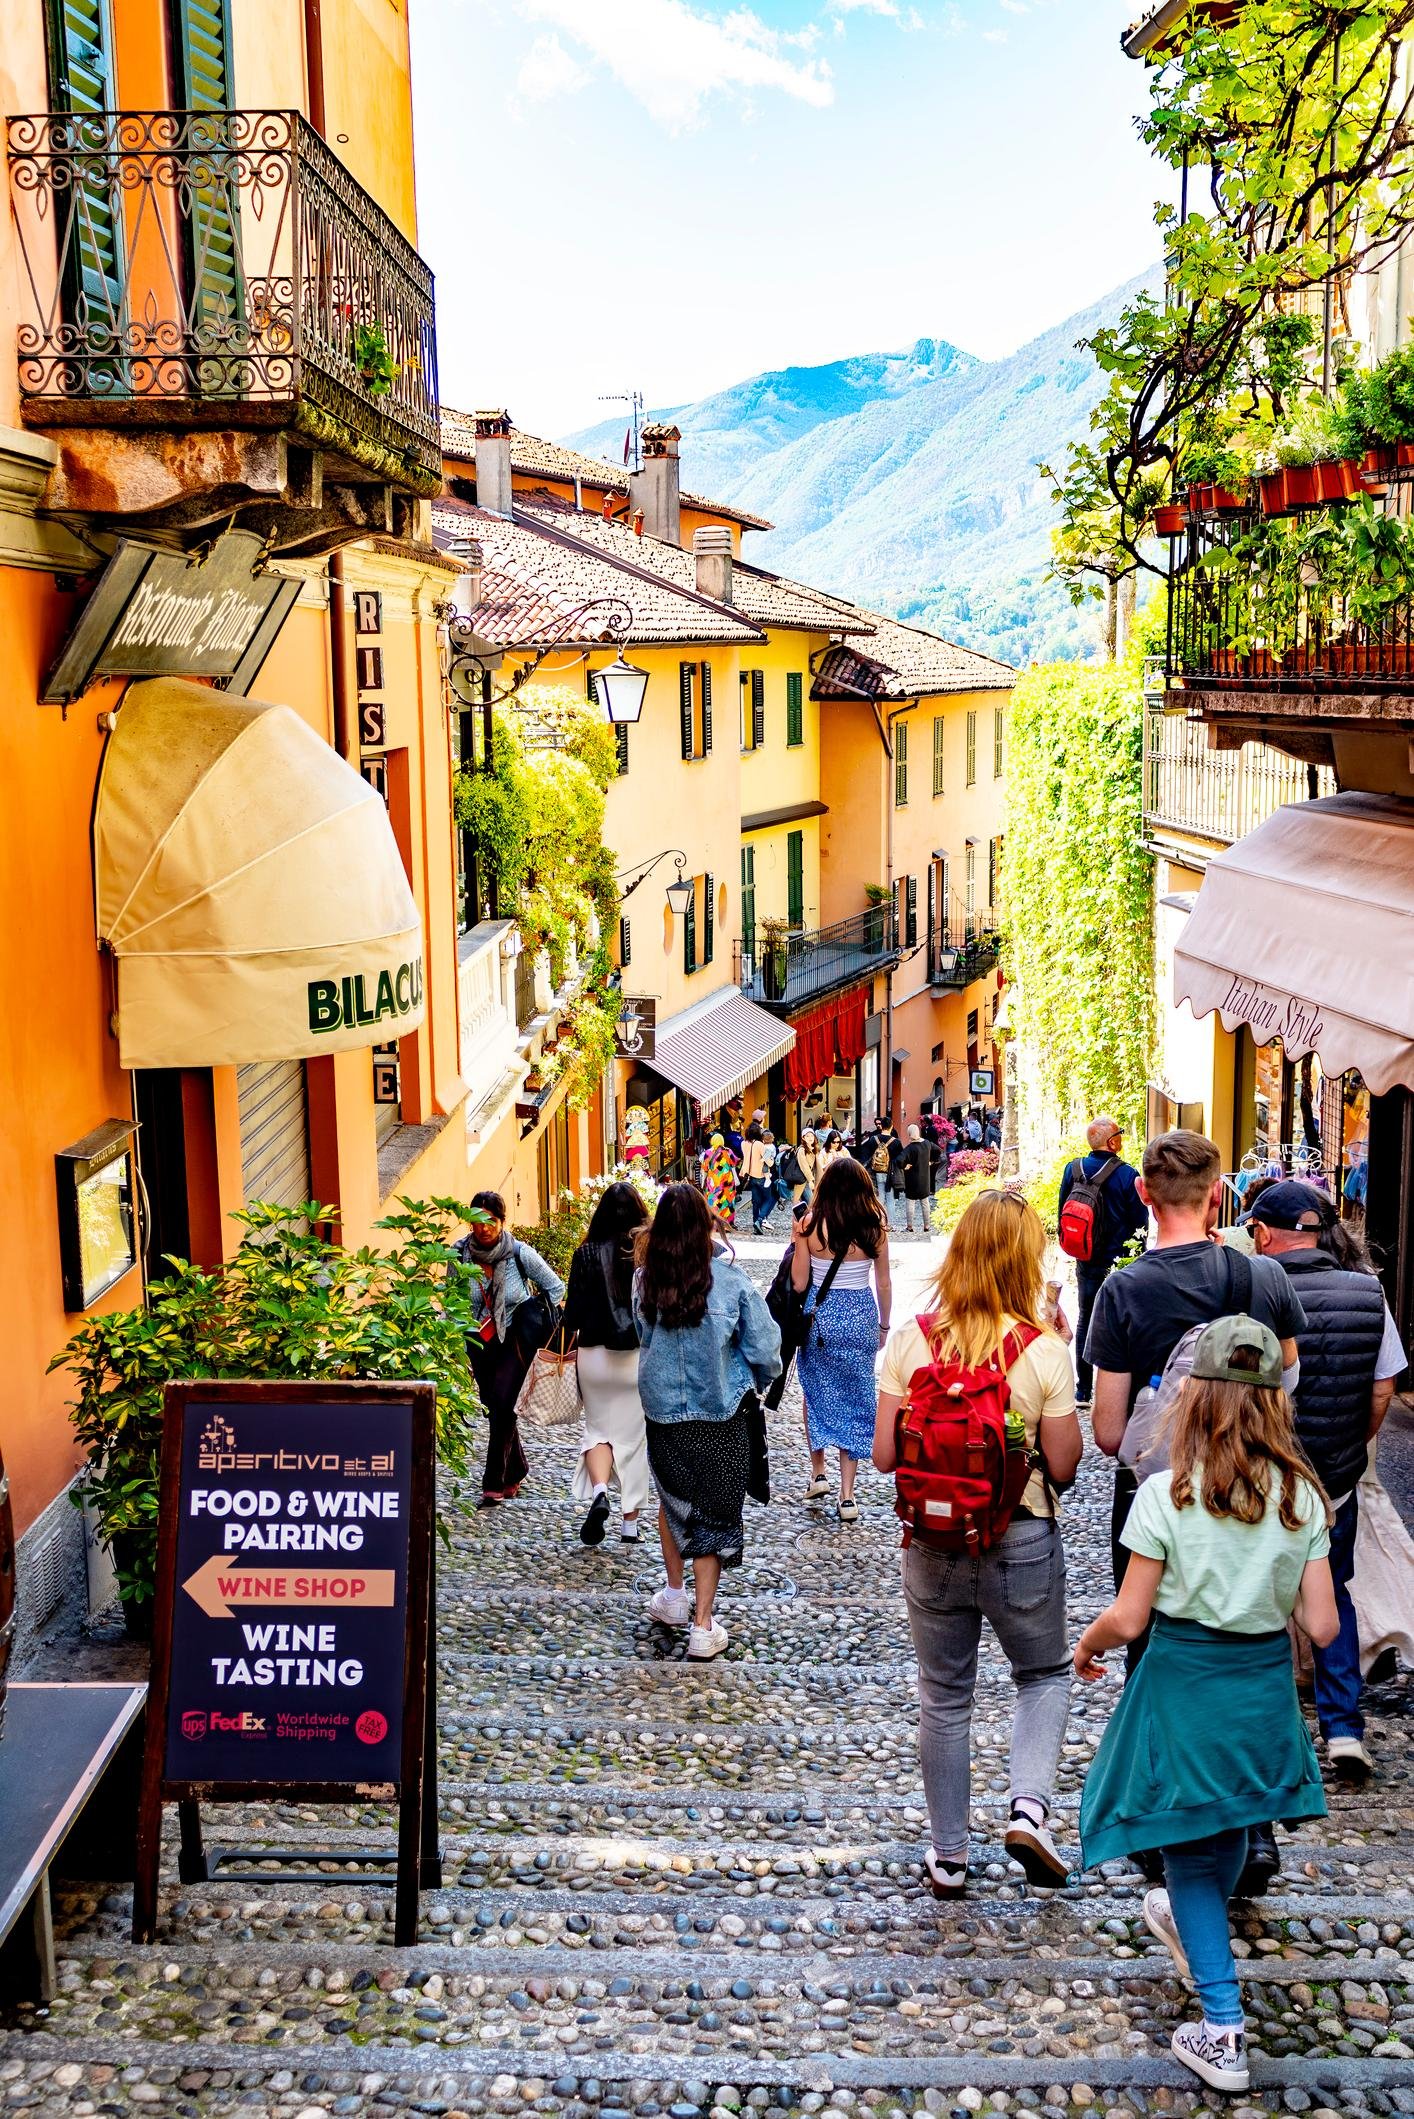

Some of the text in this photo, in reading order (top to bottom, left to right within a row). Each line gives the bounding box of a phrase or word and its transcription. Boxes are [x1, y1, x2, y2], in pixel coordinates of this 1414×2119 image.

[111, 577, 214, 651] Ristorante
[1220, 975, 1324, 1055] Italian Style
[198, 1449, 340, 1474] aperitivo
[371, 1450, 395, 1471] al
[190, 1489, 400, 1518] FOOD & WINE
[223, 1523, 364, 1551] PAIRING
[217, 1577, 366, 1599] WINE SHOP
[241, 1624, 336, 1652] WINE
[211, 1657, 364, 1686] TASTING
[183, 1711, 350, 1737] ups FedEx Worldwide
[276, 1725, 337, 1741] Shipping
[358, 1723, 382, 1740] FREE
[364, 1715, 383, 1730] TAX
[1223, 2054, 1240, 2066] you!
